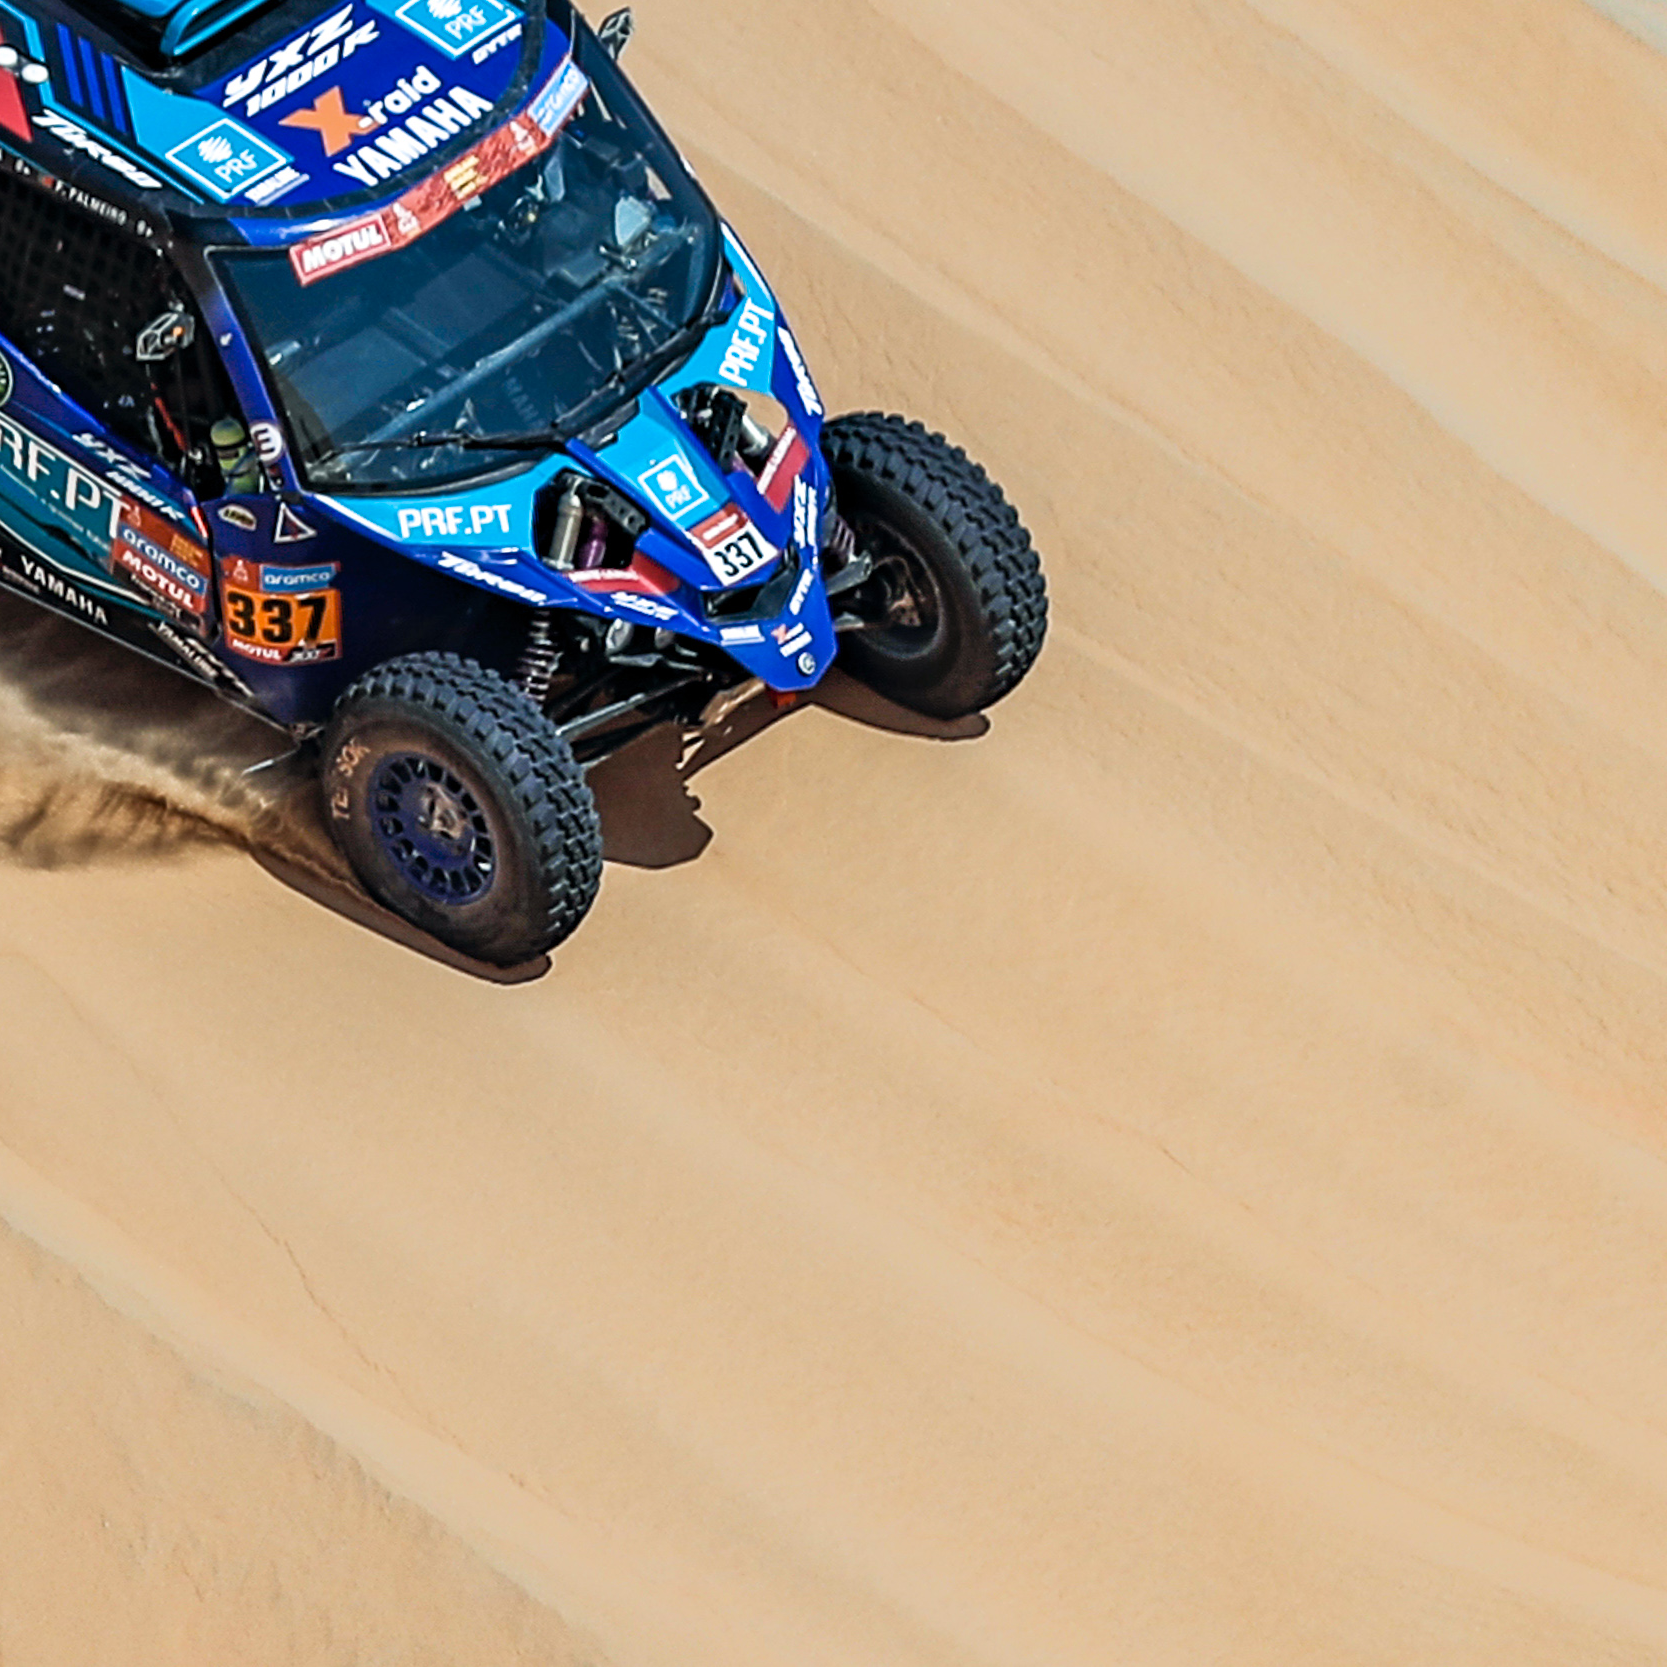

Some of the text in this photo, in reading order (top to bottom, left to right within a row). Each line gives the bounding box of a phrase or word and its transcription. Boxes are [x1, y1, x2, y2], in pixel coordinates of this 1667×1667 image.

[444, 5, 488, 40] PRF
[223, 3, 353, 108] YXZ
[246, 20, 380, 117] 1000R
[278, 65, 442, 157] X-raid
[333, 86, 494, 187] YAMAHA
[215, 149, 259, 182] PRF
[69, 187, 127, 226] PALMEIRO
[302, 224, 383, 272] MOTUL
[718, 296, 775, 387] PRF.PT
[72, 433, 152, 481] YXZ
[397, 503, 513, 539] PRF.PT
[123, 529, 200, 589] aramco
[264, 569, 332, 586] aramco
[713, 531, 764, 576] 337
[21, 555, 108, 626] YAMAHA
[122, 550, 194, 609] MOTUL
[227, 591, 328, 644] 337
[231, 638, 283, 661] MOTUL
